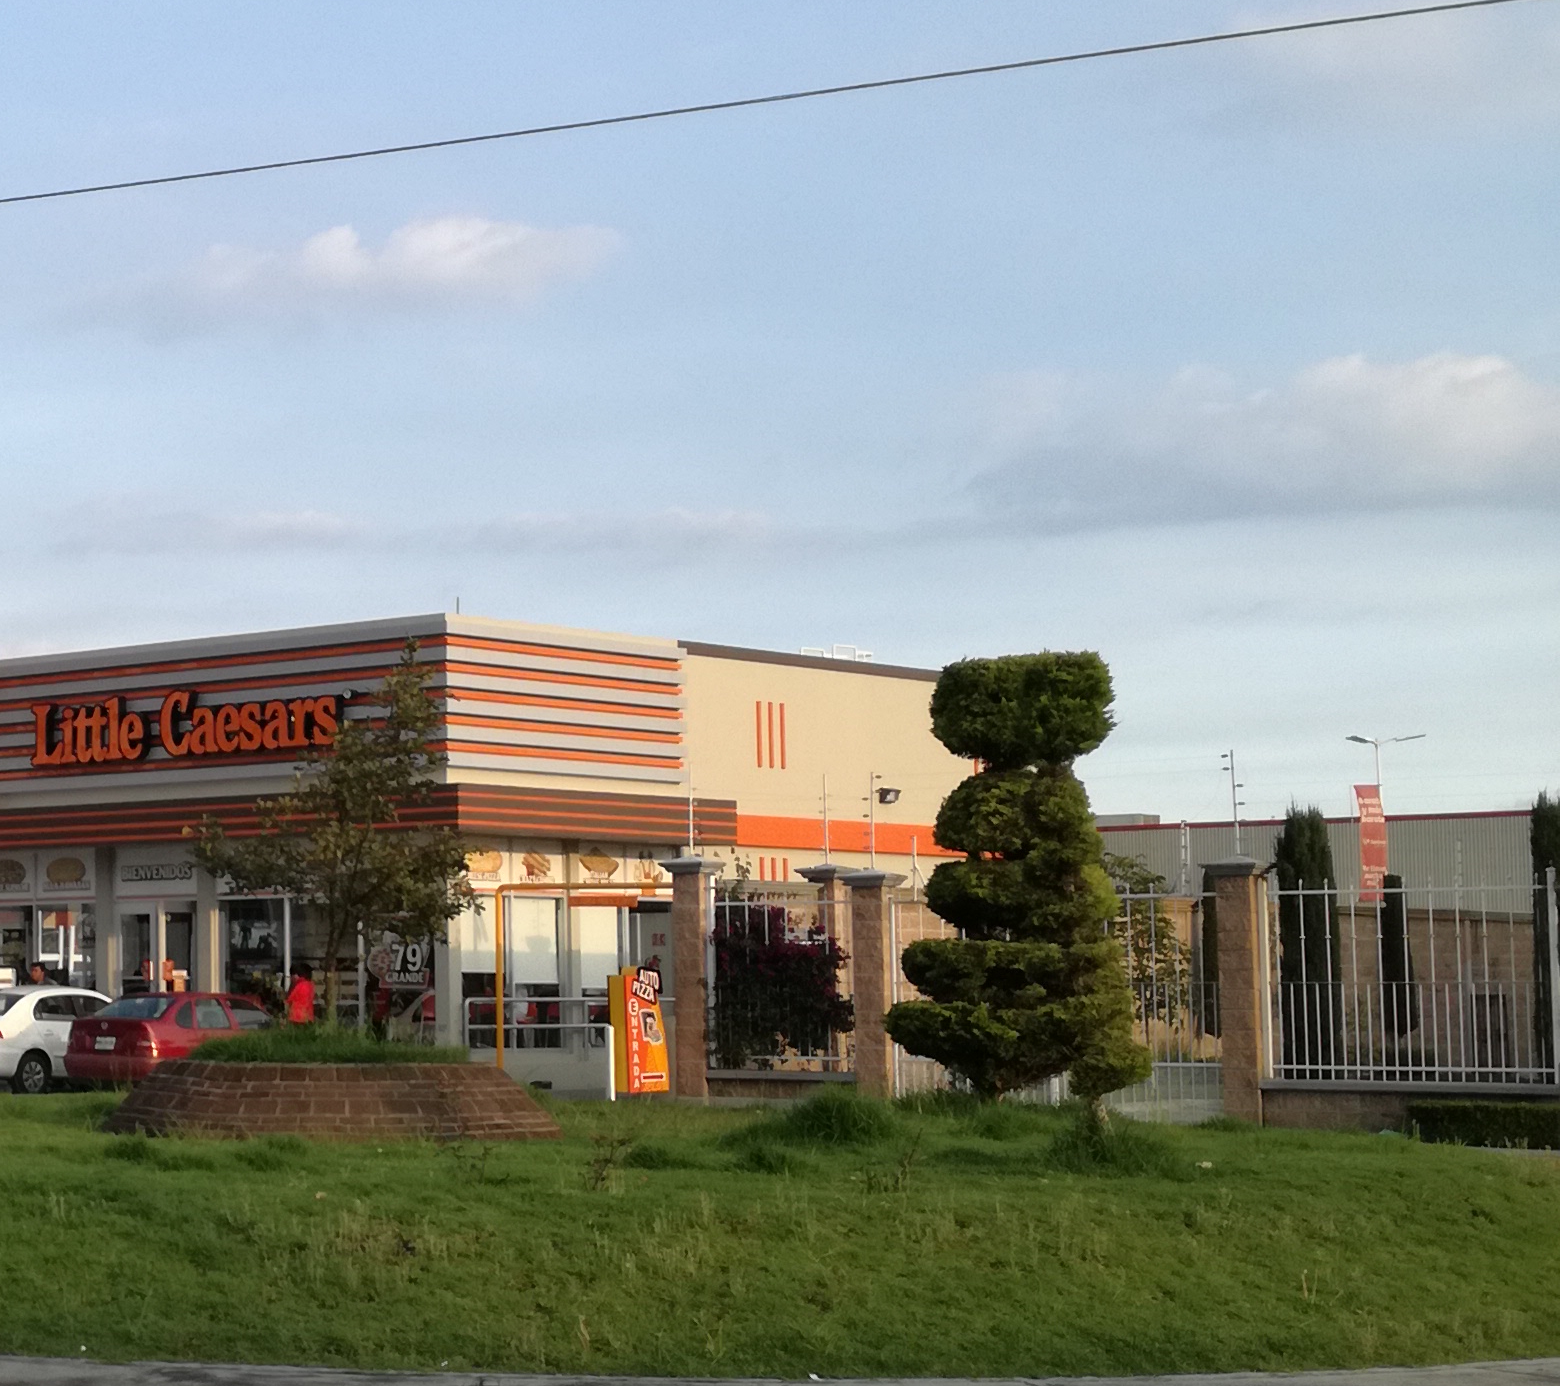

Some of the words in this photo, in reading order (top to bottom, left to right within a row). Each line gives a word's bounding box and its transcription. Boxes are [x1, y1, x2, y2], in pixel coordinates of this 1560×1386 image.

[31, 696, 145, 766] Little
[160, 689, 339, 757] Caesars
[121, 863, 191, 882] BIENVENIDOS
[384, 971, 424, 983] GRANDE
[639, 969, 659, 991] AUTO
[632, 980, 656, 1003] PIZZA
[628, 998, 641, 1089] ENTRADA
